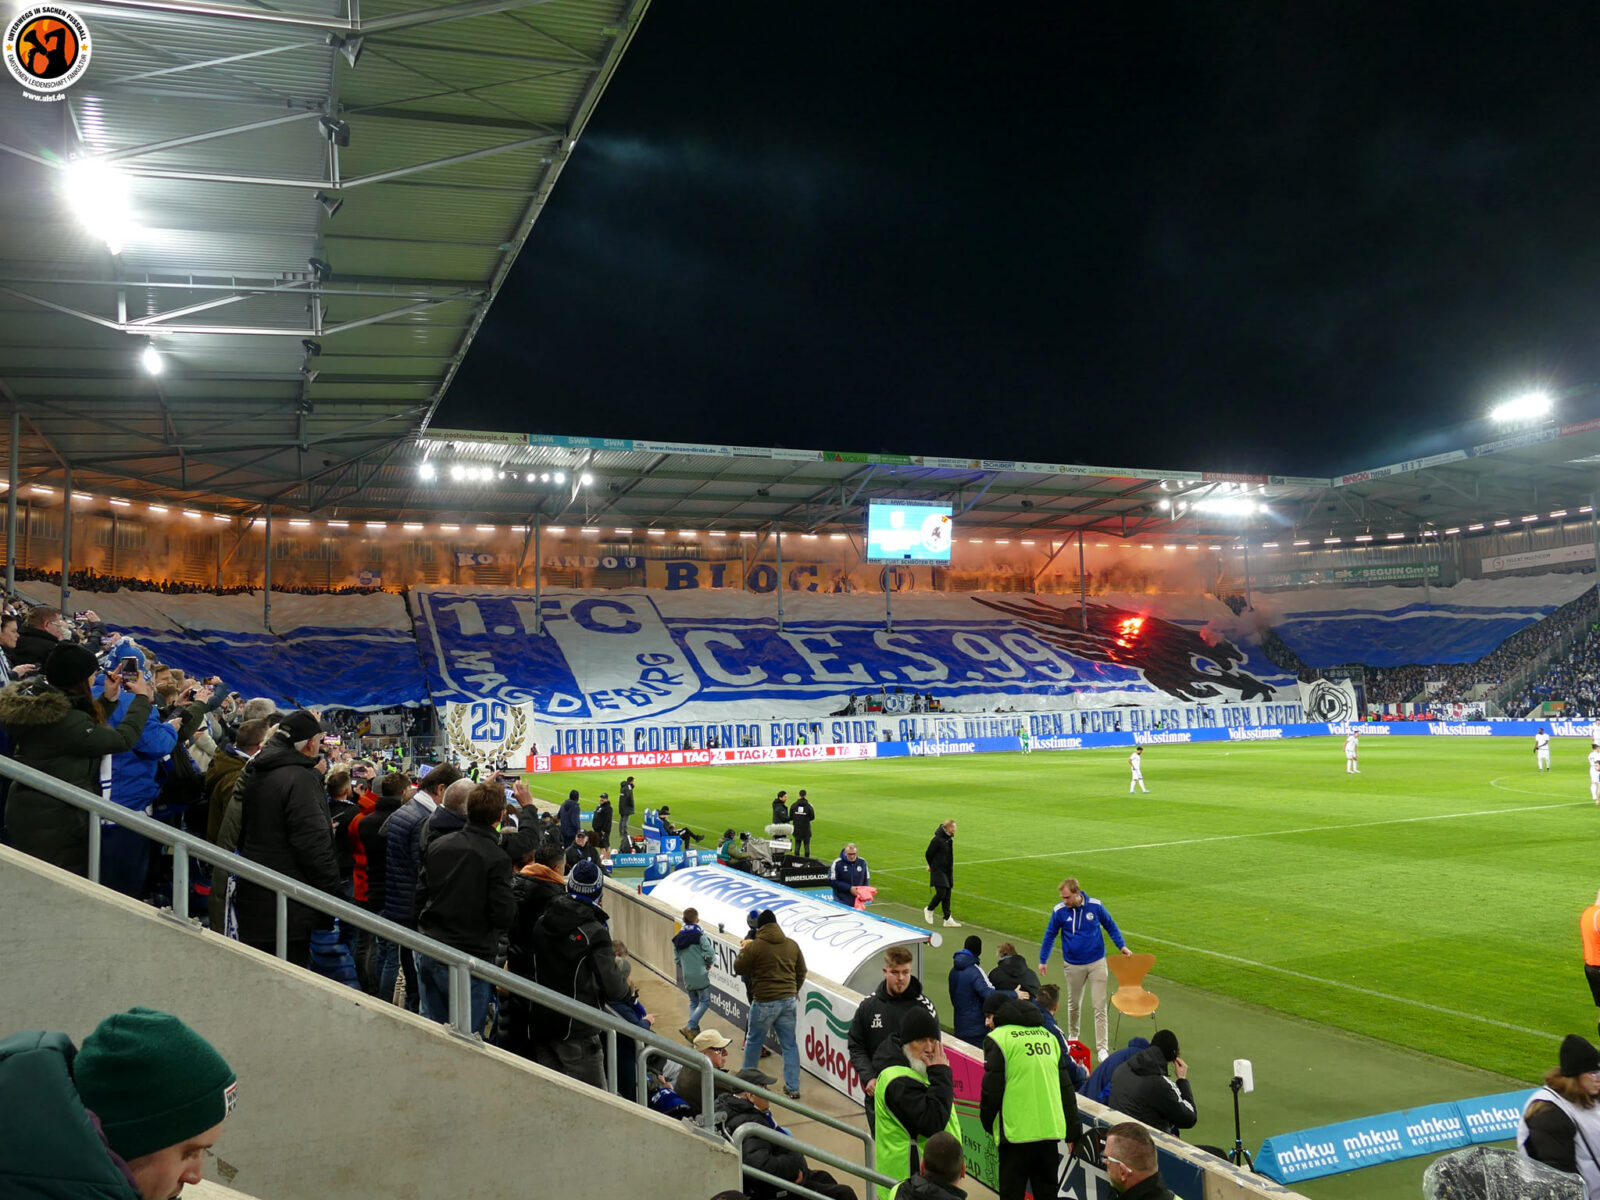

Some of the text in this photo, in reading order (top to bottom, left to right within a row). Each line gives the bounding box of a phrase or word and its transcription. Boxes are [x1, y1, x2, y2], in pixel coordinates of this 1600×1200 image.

[532, 435, 554, 443] SWM
[568, 437, 590, 445] SWM
[603, 439, 625, 447] SWM
[450, 649, 684, 715] MAGDEBURG
[471, 702, 508, 742] 25
[551, 727, 625, 755] JAHRE
[634, 723, 761, 751] COMMANDO
[770, 721, 824, 747] EAST
[832, 719, 878, 744] SIDE
[898, 716, 958, 741] ALLES
[1029, 713, 1063, 737] DEN
[1130, 708, 1181, 731] ALLES
[1221, 705, 1252, 728] DEN
[1328, 722, 1390, 736] Volksstimme
[1428, 722, 1492, 736] Volksstimme
[1551, 721, 1595, 736] Volksst
[1133, 731, 1191, 745] Volksstimme
[1228, 727, 1282, 740] Volksstimme
[907, 741, 975, 755] Volksstimme
[1019, 735, 1082, 751] lksstimme
[674, 869, 800, 913] HORIBA
[708, 937, 738, 978] END
[709, 991, 741, 1019] end-sgl.de
[1010, 1029, 1050, 1038] Security
[1024, 1042, 1051, 1057] 360
[805, 1025, 867, 1097] dekop
[1466, 1107, 1521, 1127] mhkw
[1406, 1116, 1461, 1138] mhkw
[1471, 1120, 1519, 1135] ROTHENSE
[1343, 1128, 1400, 1151] mhkw
[1411, 1130, 1465, 1147] ROTHENSEE
[1277, 1141, 1336, 1166] mhkw
[1348, 1141, 1403, 1159] ROTHENSEE
[1282, 1155, 1339, 1174] ROTHENSEE
